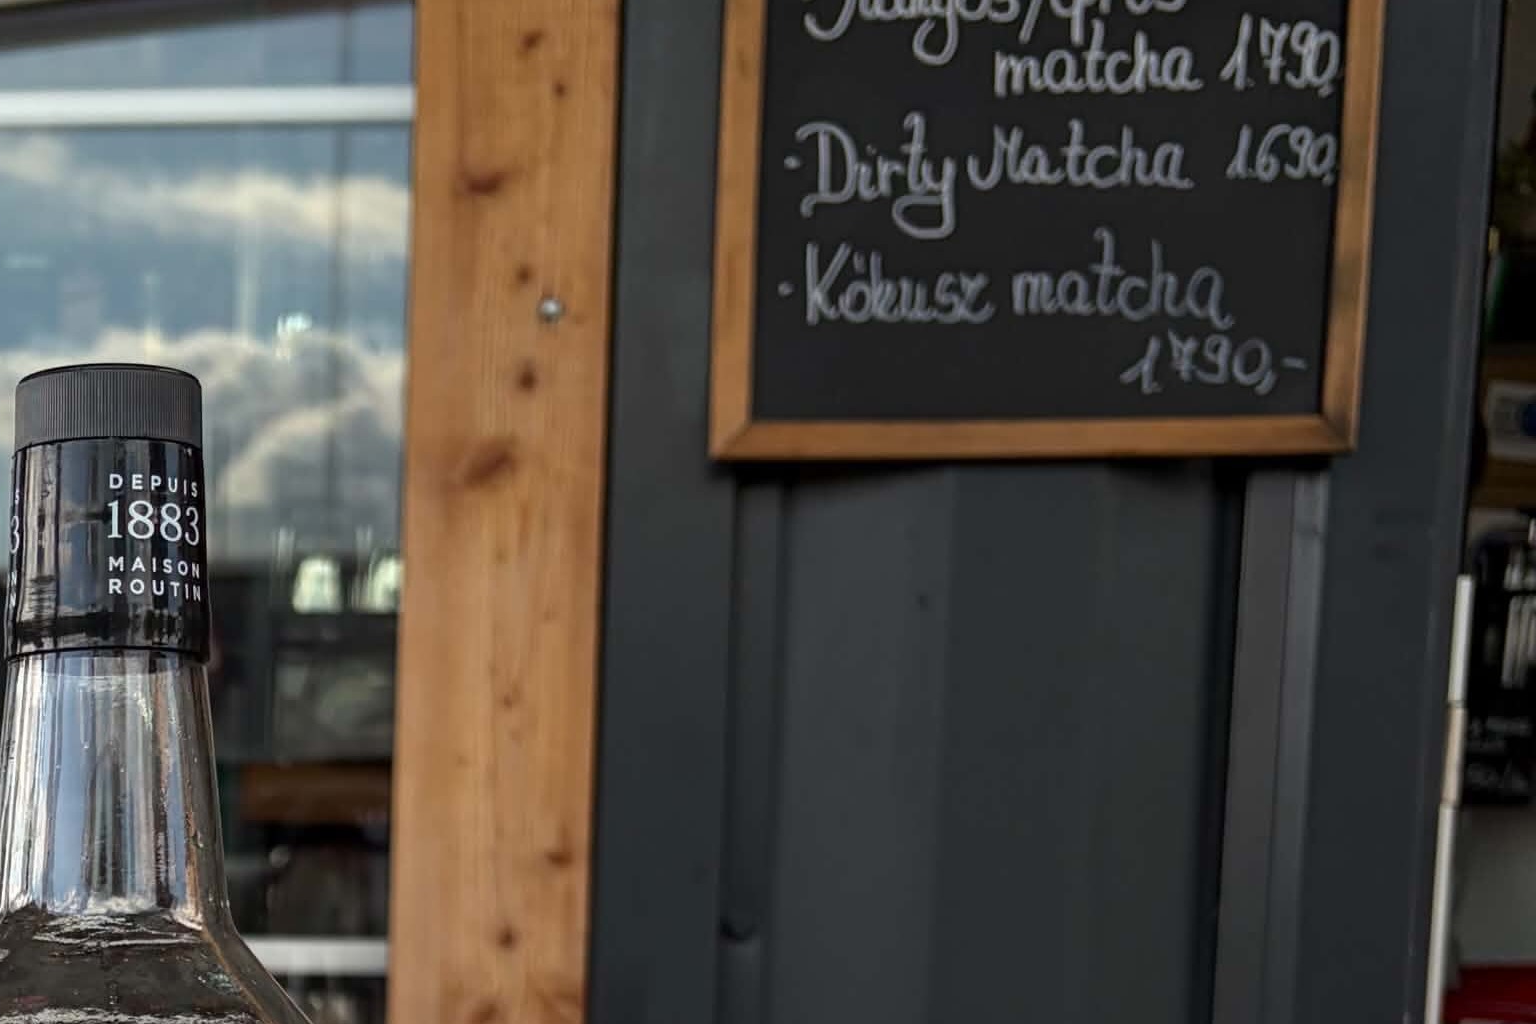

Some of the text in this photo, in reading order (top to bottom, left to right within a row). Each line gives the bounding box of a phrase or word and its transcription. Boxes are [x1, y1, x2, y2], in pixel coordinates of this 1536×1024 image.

[995, 20, 1202, 97] matcha
[795, 112, 957, 238] Dirty
[967, 120, 1194, 188] Matcha
[1012, 227, 1234, 328] matcha
[109, 473, 198, 498] DEPUIS
[107, 499, 200, 547] 1883
[108, 555, 200, 580] MAISON
[108, 579, 202, 603] ROUTIN
